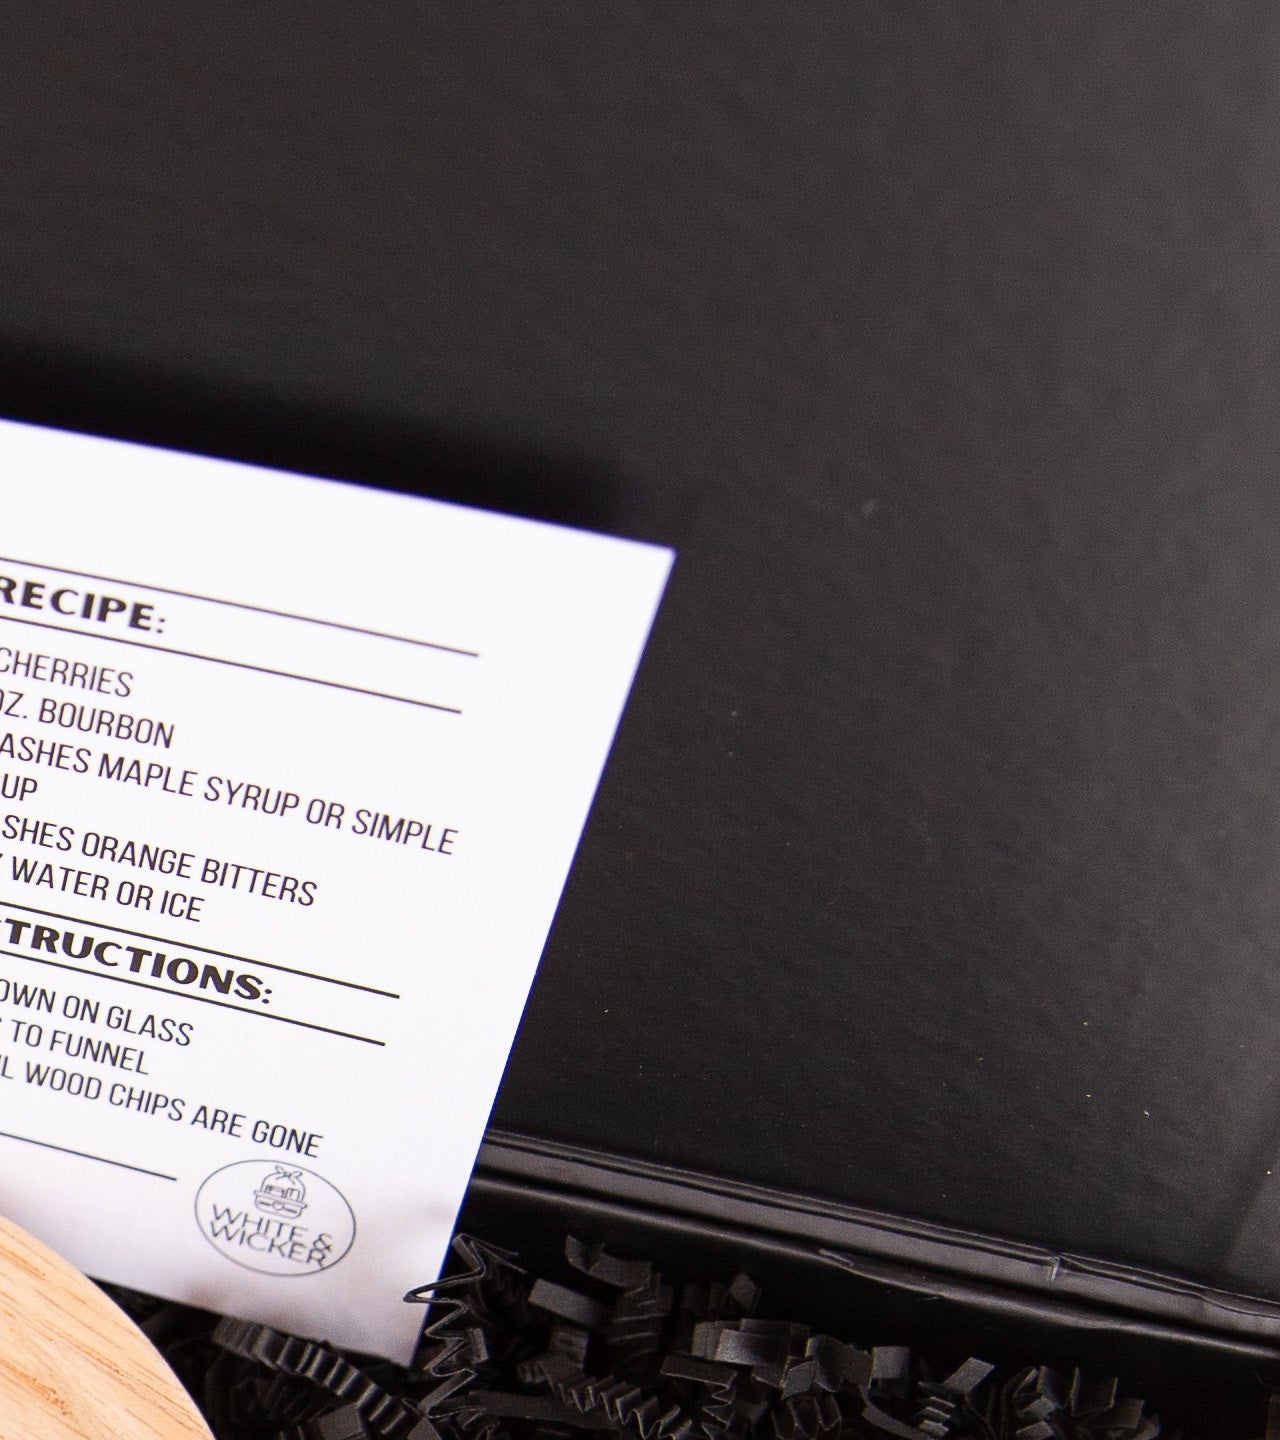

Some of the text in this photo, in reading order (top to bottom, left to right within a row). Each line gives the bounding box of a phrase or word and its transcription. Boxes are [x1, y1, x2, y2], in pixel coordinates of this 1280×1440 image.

[38, 697, 175, 749] BOURBON
[97, 752, 198, 797] MAPLE
[203, 776, 300, 817] SYRUP
[305, 798, 345, 830] OR
[351, 808, 459, 856] SIMPLE
[12, 855, 110, 901] WATER
[116, 880, 154, 911] OR
[159, 889, 206, 923] ICE
[81, 832, 196, 879] ORANGE
[200, 857, 318, 907] BITTERS
[11, 1019, 43, 1048] TO
[49, 1029, 149, 1076] FUNNEL
[62, 995, 101, 1024] ON
[105, 1005, 194, 1047] GLASS
[26, 1061, 103, 1100] WOOD
[108, 1083, 186, 1122] CHIPS
[190, 1104, 247, 1138] ARE
[251, 1119, 324, 1159] GONE
[211, 1221, 326, 1268] WICKER
[213, 1204, 332, 1252] WHITE &
